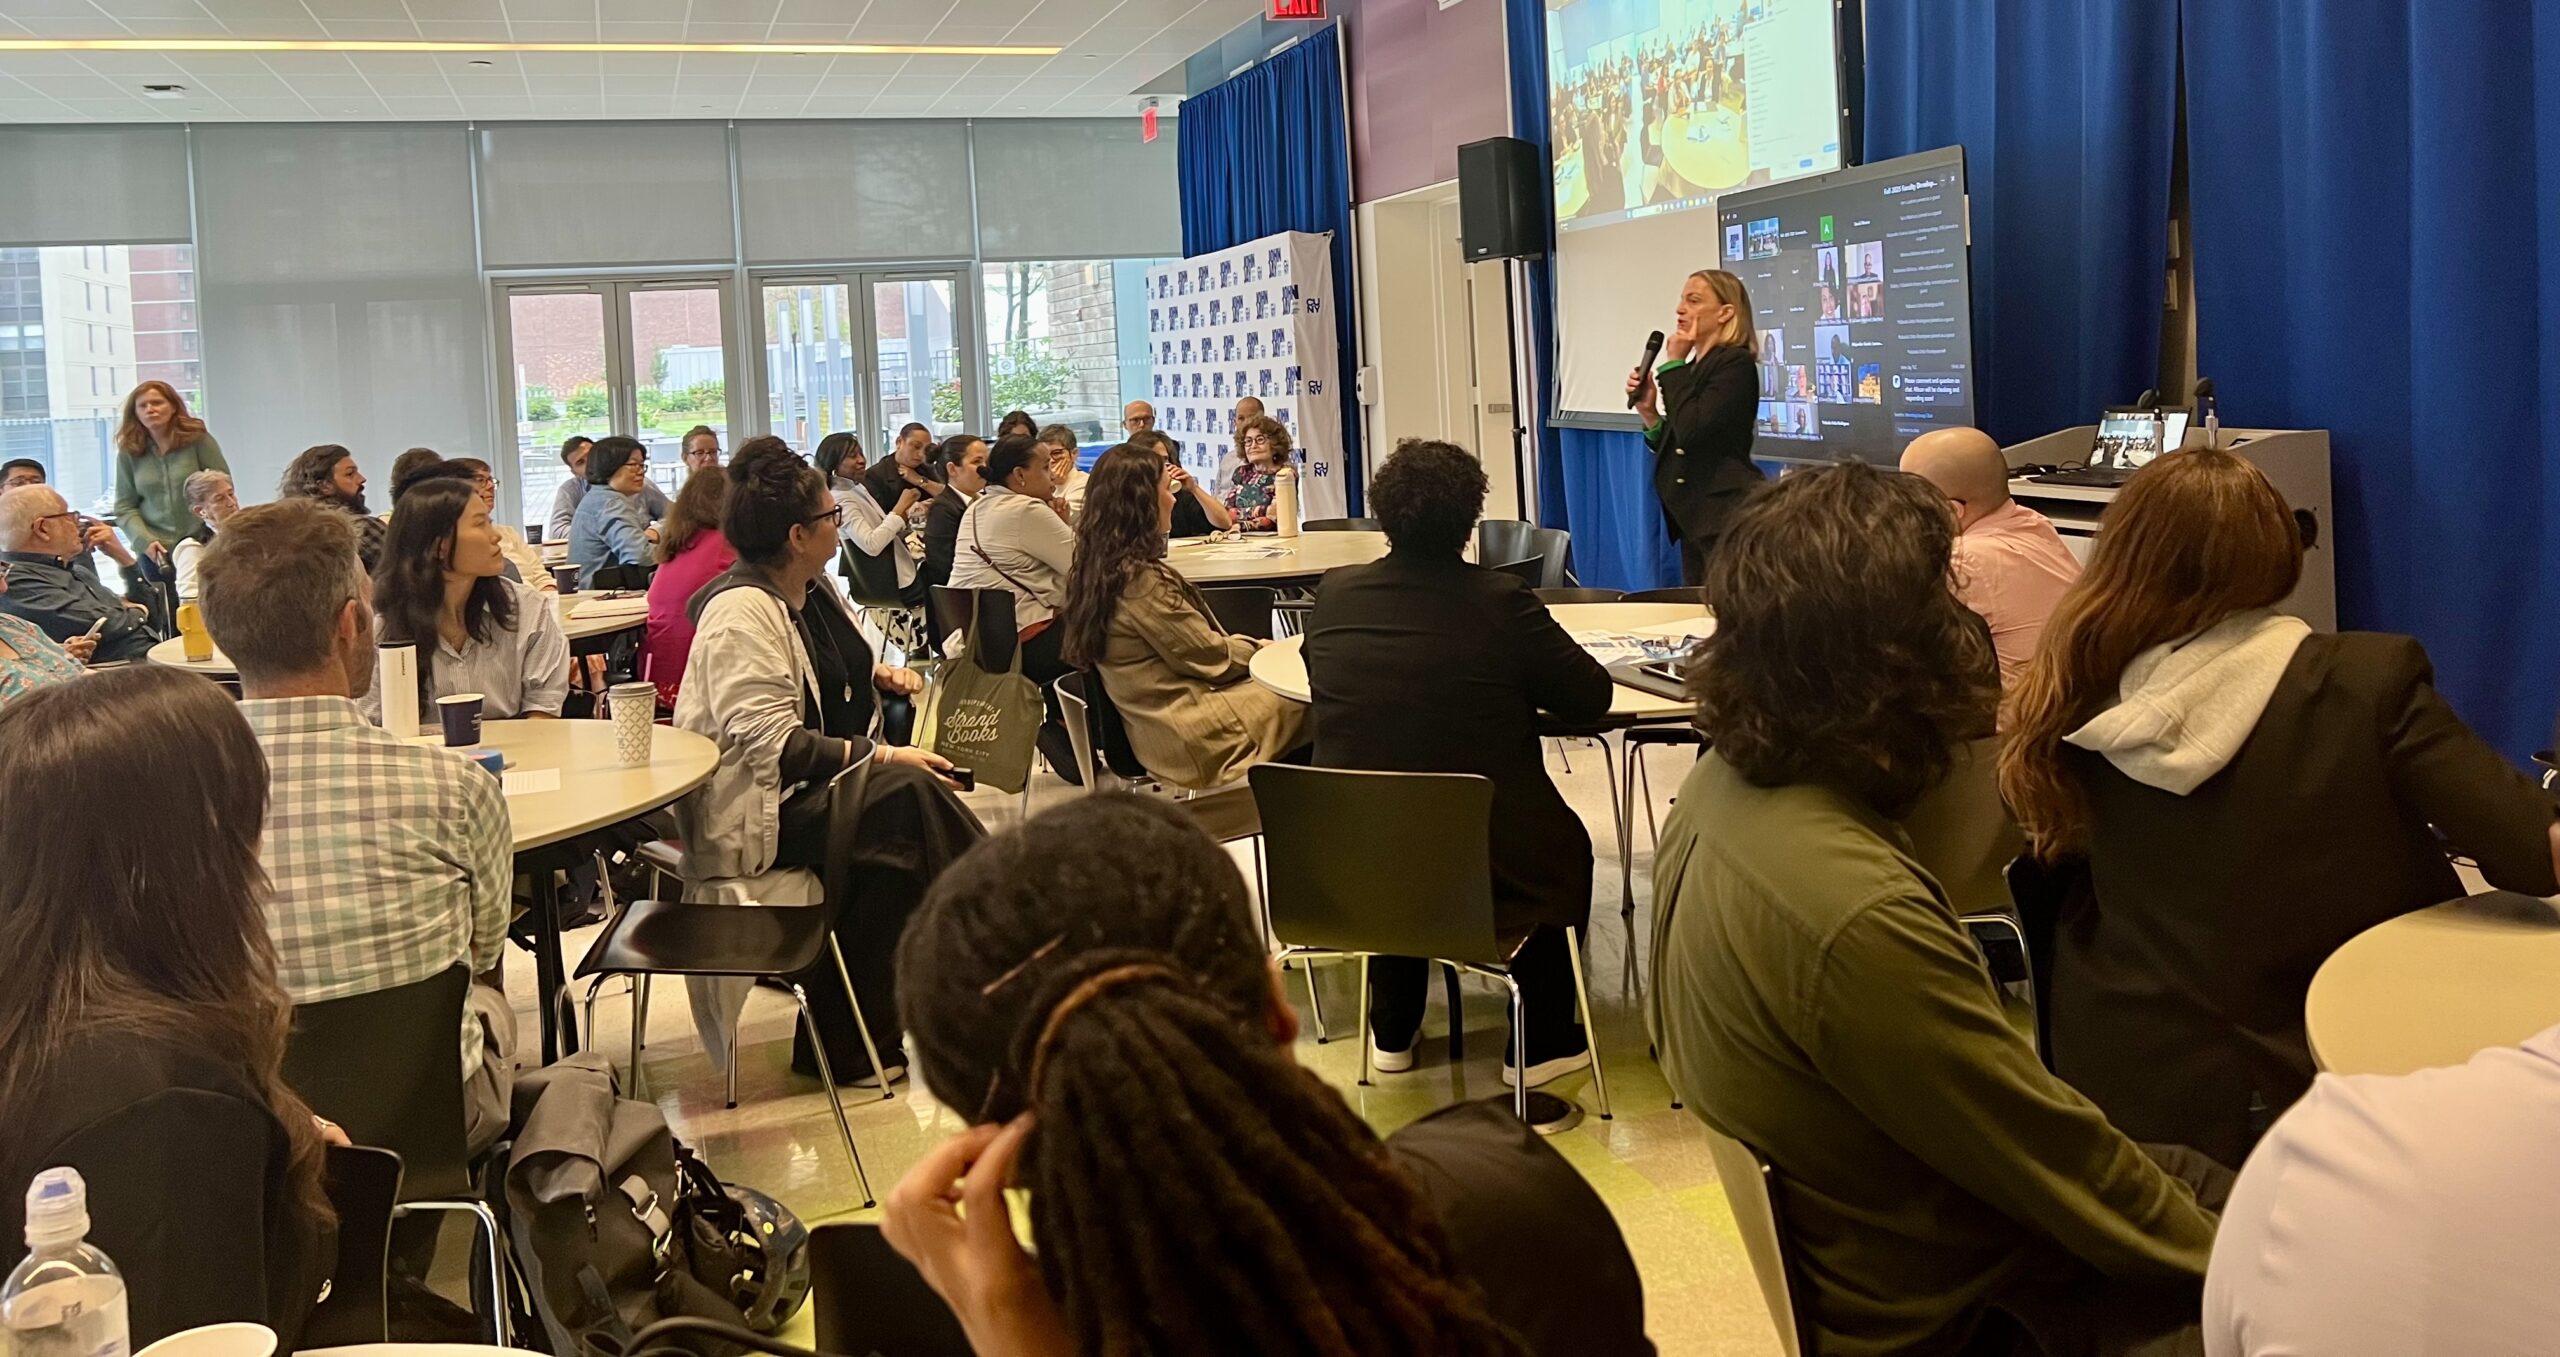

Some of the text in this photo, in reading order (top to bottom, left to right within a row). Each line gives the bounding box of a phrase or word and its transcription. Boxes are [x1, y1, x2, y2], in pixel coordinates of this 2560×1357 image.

[1313, 461, 1329, 470] CU
[1314, 468, 1329, 477] NY
[944, 708, 1002, 728] Strand
[947, 725, 999, 744] Books
